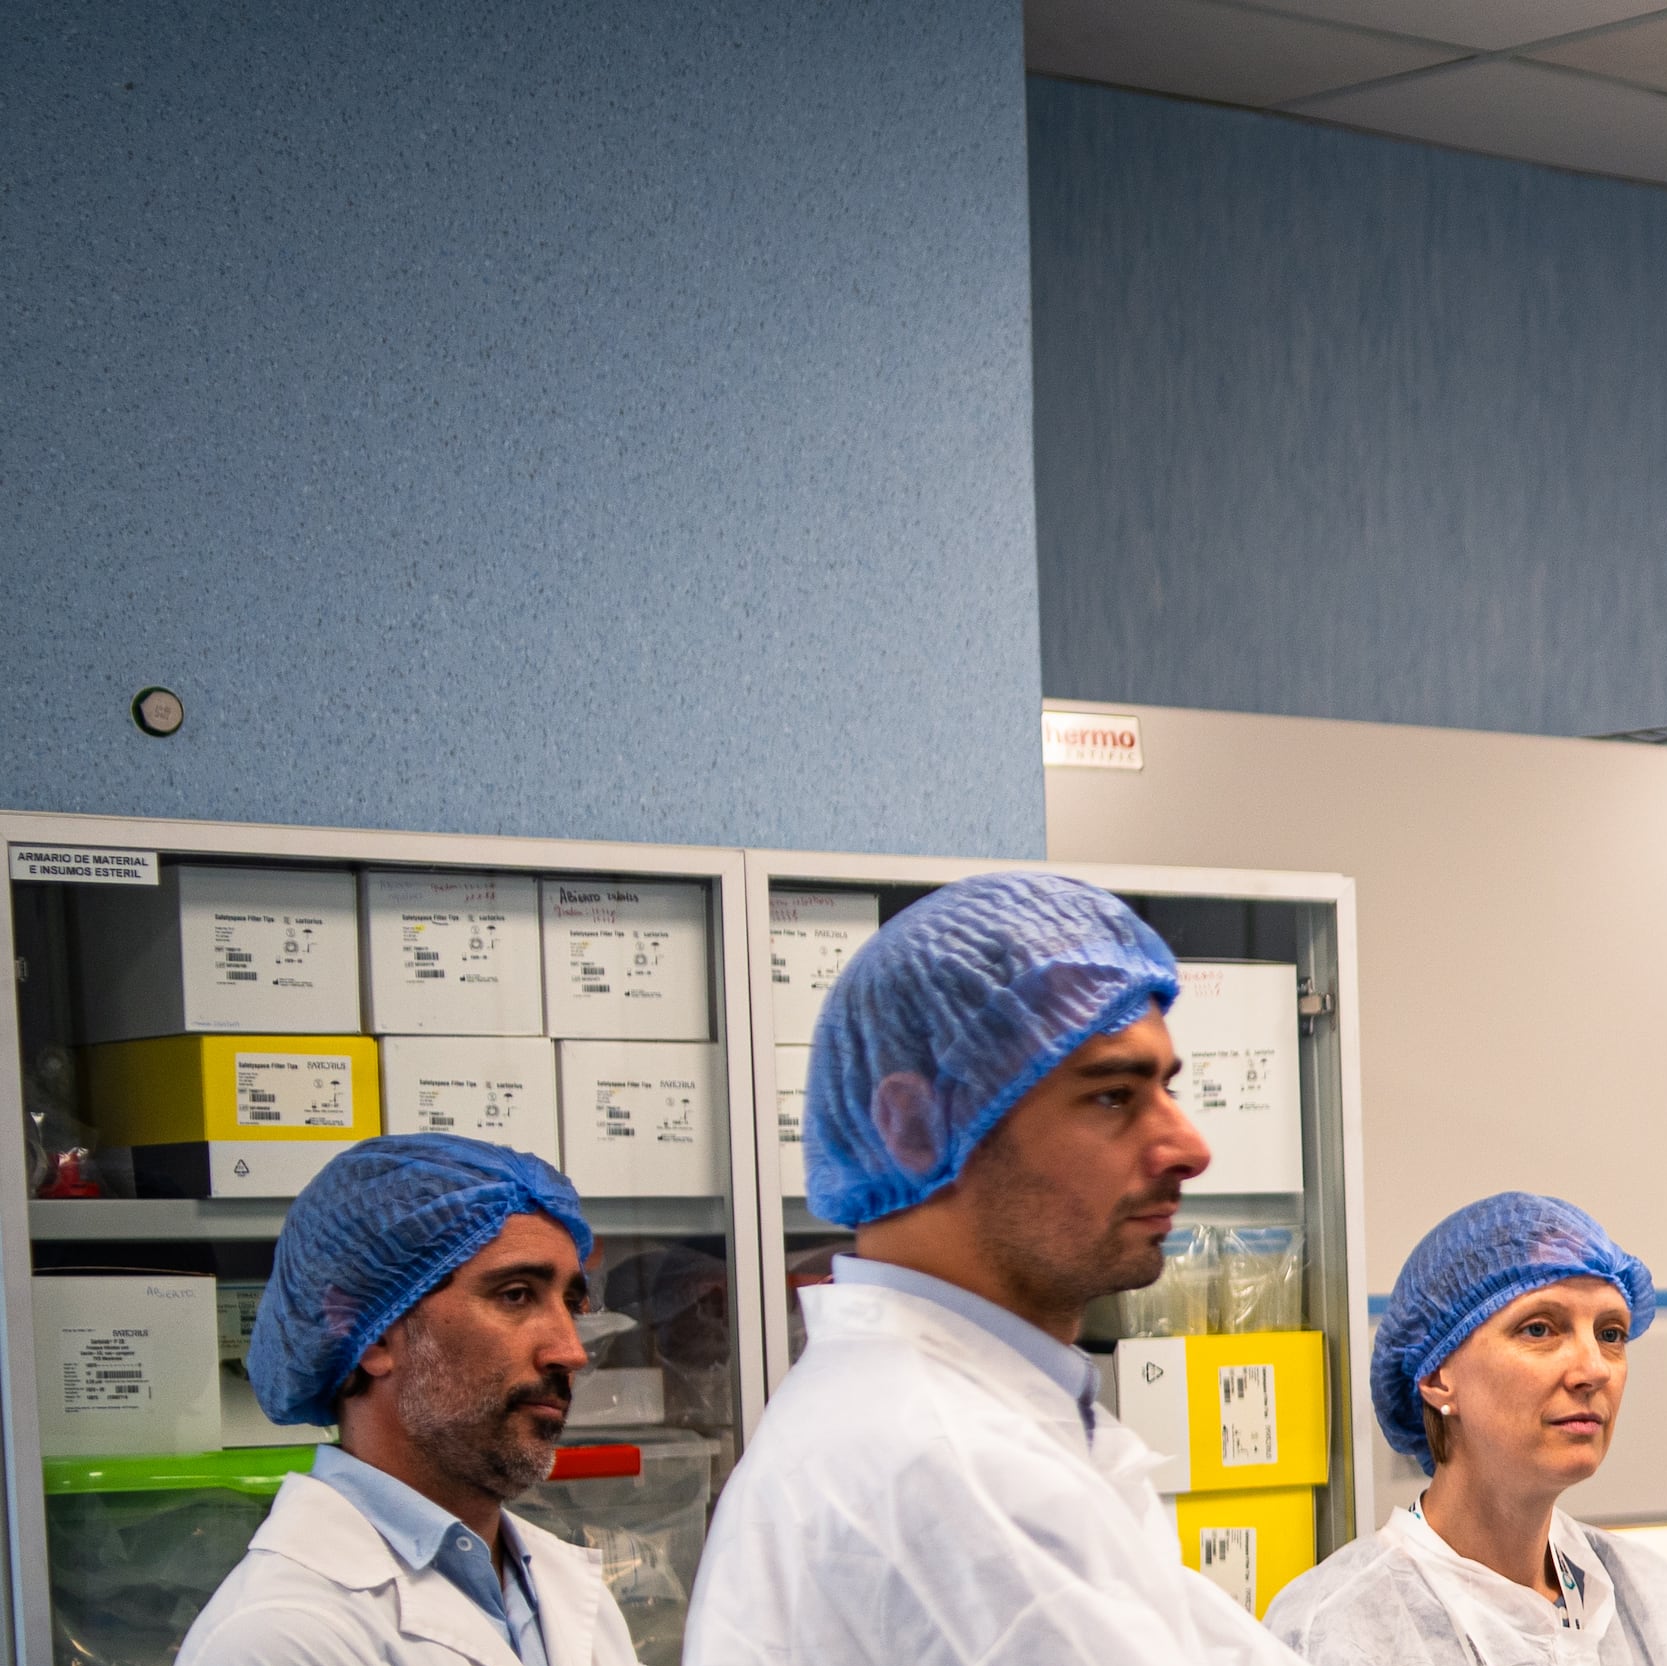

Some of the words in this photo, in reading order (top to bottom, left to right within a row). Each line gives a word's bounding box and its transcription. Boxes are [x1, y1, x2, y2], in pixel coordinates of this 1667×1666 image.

[1044, 721, 1135, 748] hermo
[17, 852, 71, 863] ARMARIO
[74, 854, 90, 864] DE
[92, 855, 148, 866] MATERIAL
[29, 865, 37, 874] E
[40, 865, 91, 876] INSUMOS
[95, 867, 141, 878] ESTERIL
